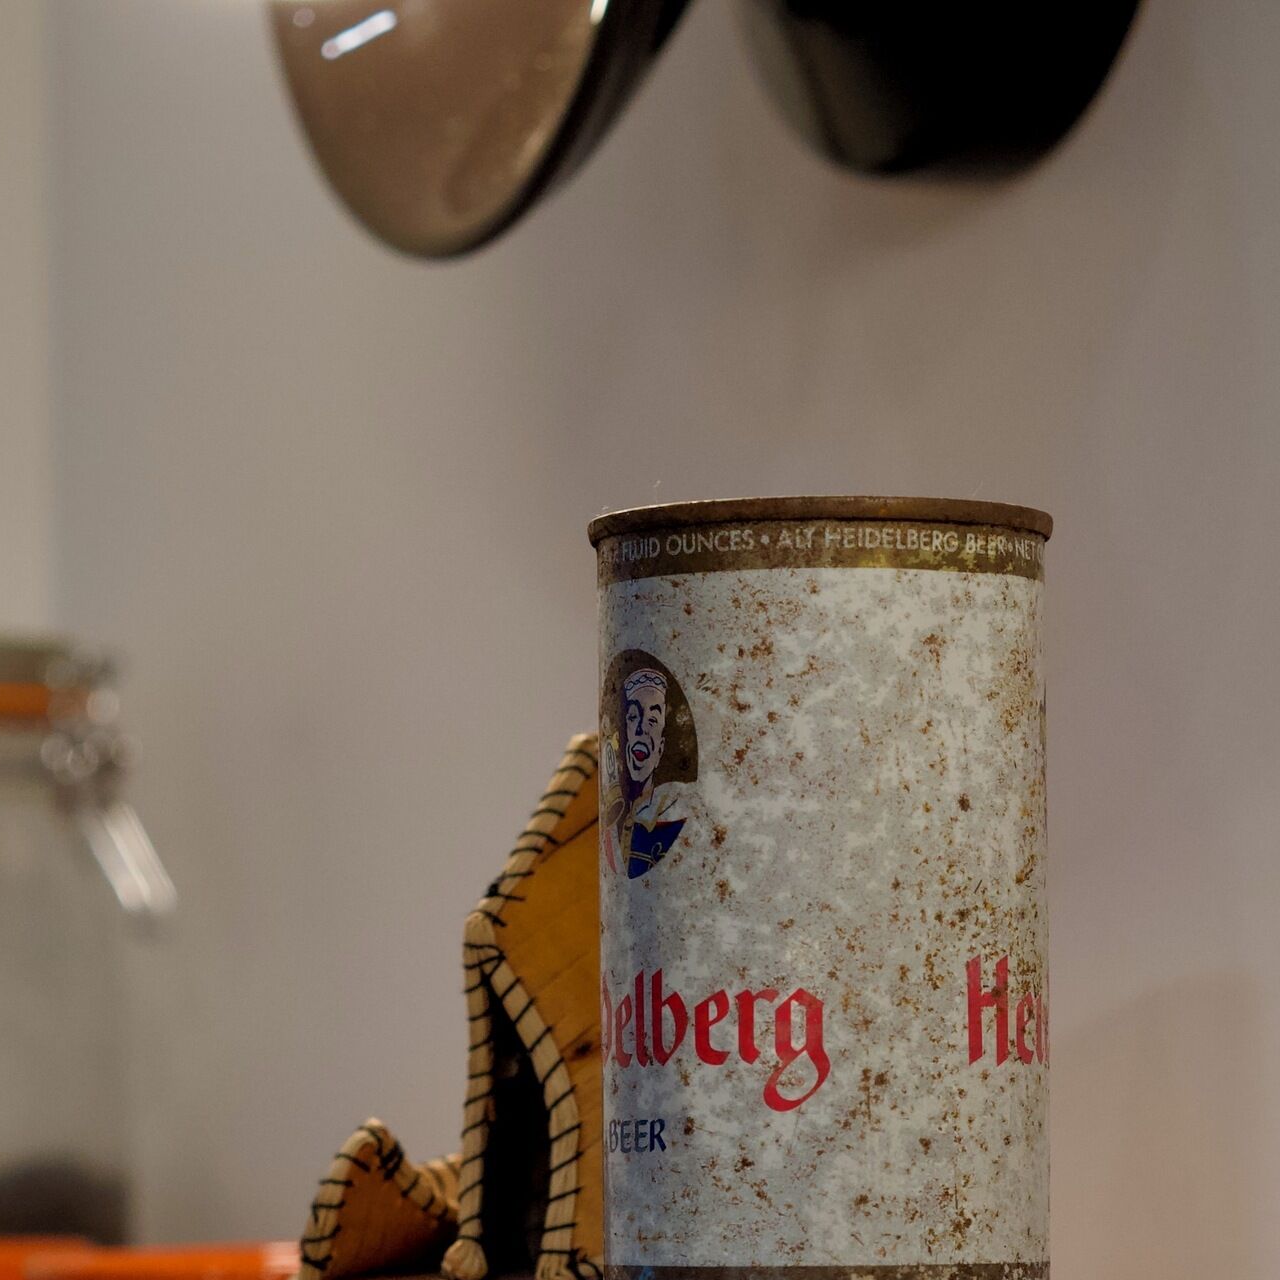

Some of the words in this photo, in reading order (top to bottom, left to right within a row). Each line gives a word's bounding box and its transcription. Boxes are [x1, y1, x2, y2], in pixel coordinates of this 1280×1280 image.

[622, 536, 661, 562] FLUID
[666, 529, 754, 556] OUNCES
[824, 526, 958, 553] HEIDELBERG
[965, 532, 1006, 556] BEER
[608, 1118, 667, 1154] BEER
